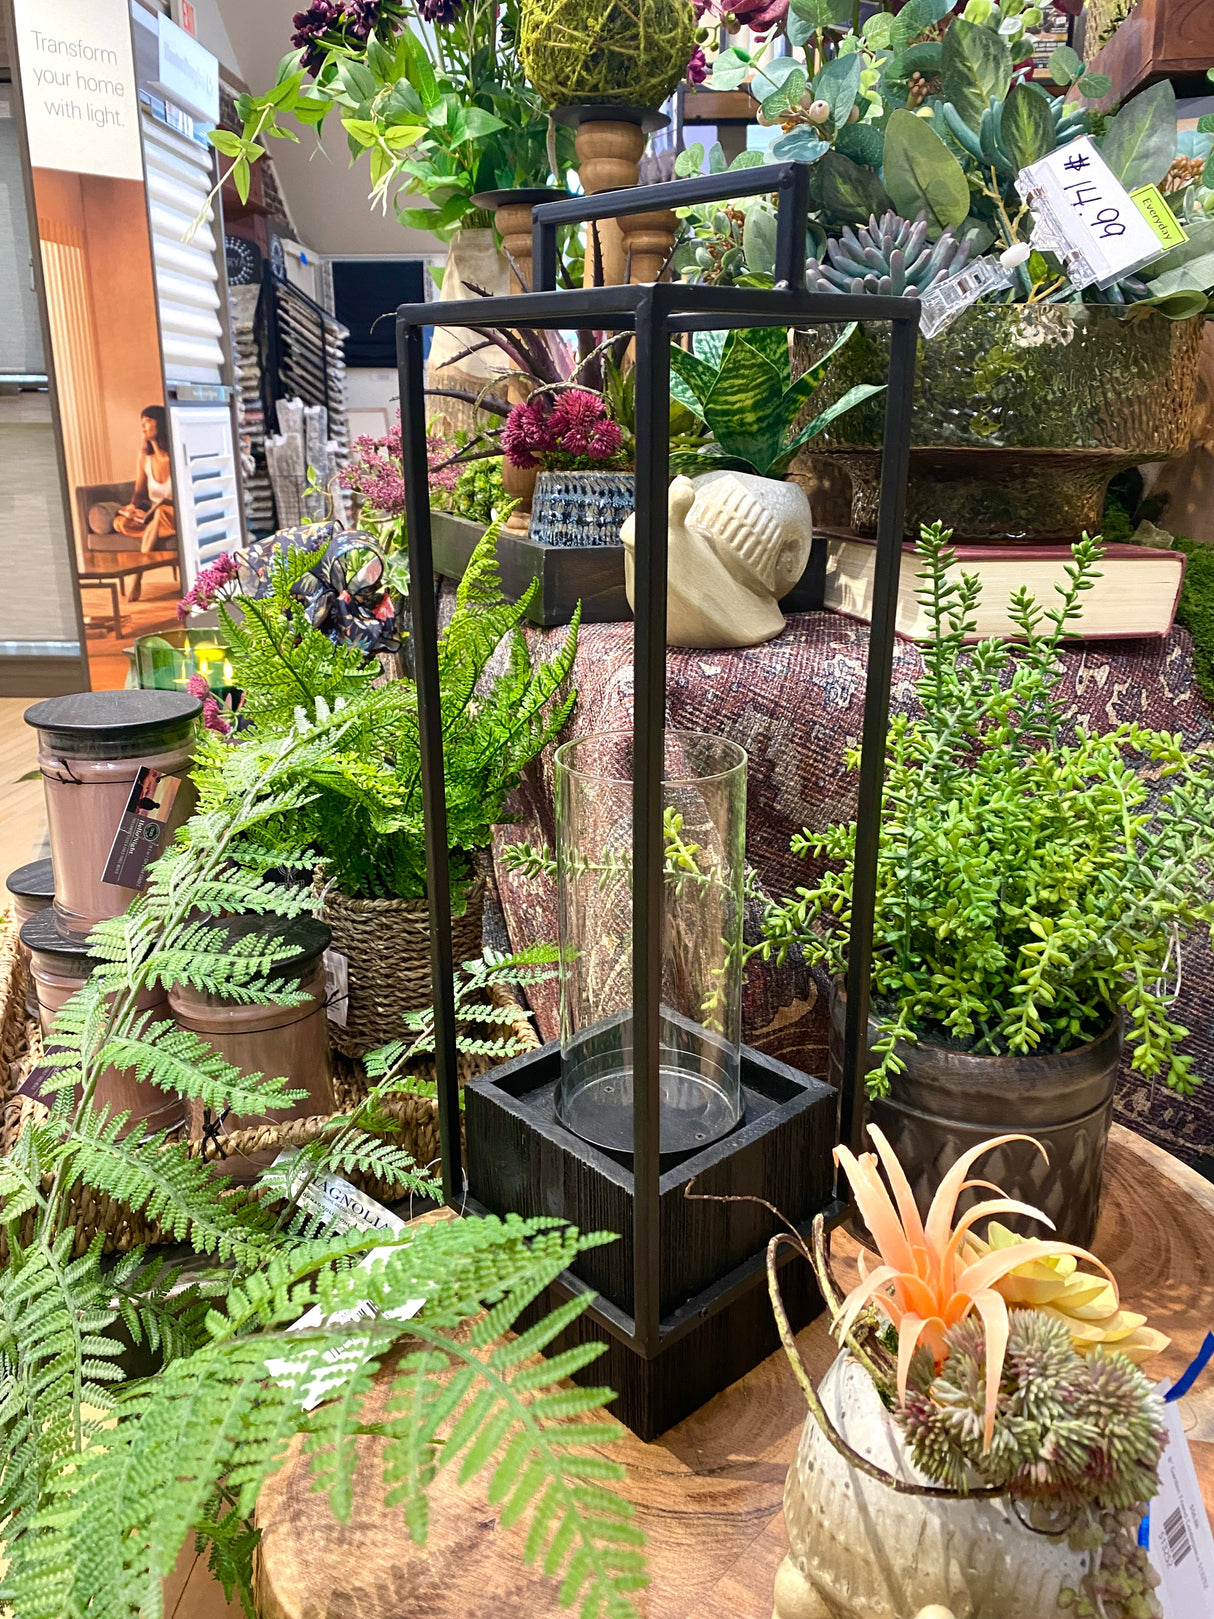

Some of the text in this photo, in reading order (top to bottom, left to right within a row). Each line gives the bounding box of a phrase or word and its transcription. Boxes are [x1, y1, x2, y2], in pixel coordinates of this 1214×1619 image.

[31, 30, 117, 65] Transform
[33, 67, 124, 97] your home
[44, 98, 125, 128] with light.
[1142, 197, 1172, 241] Everyday
